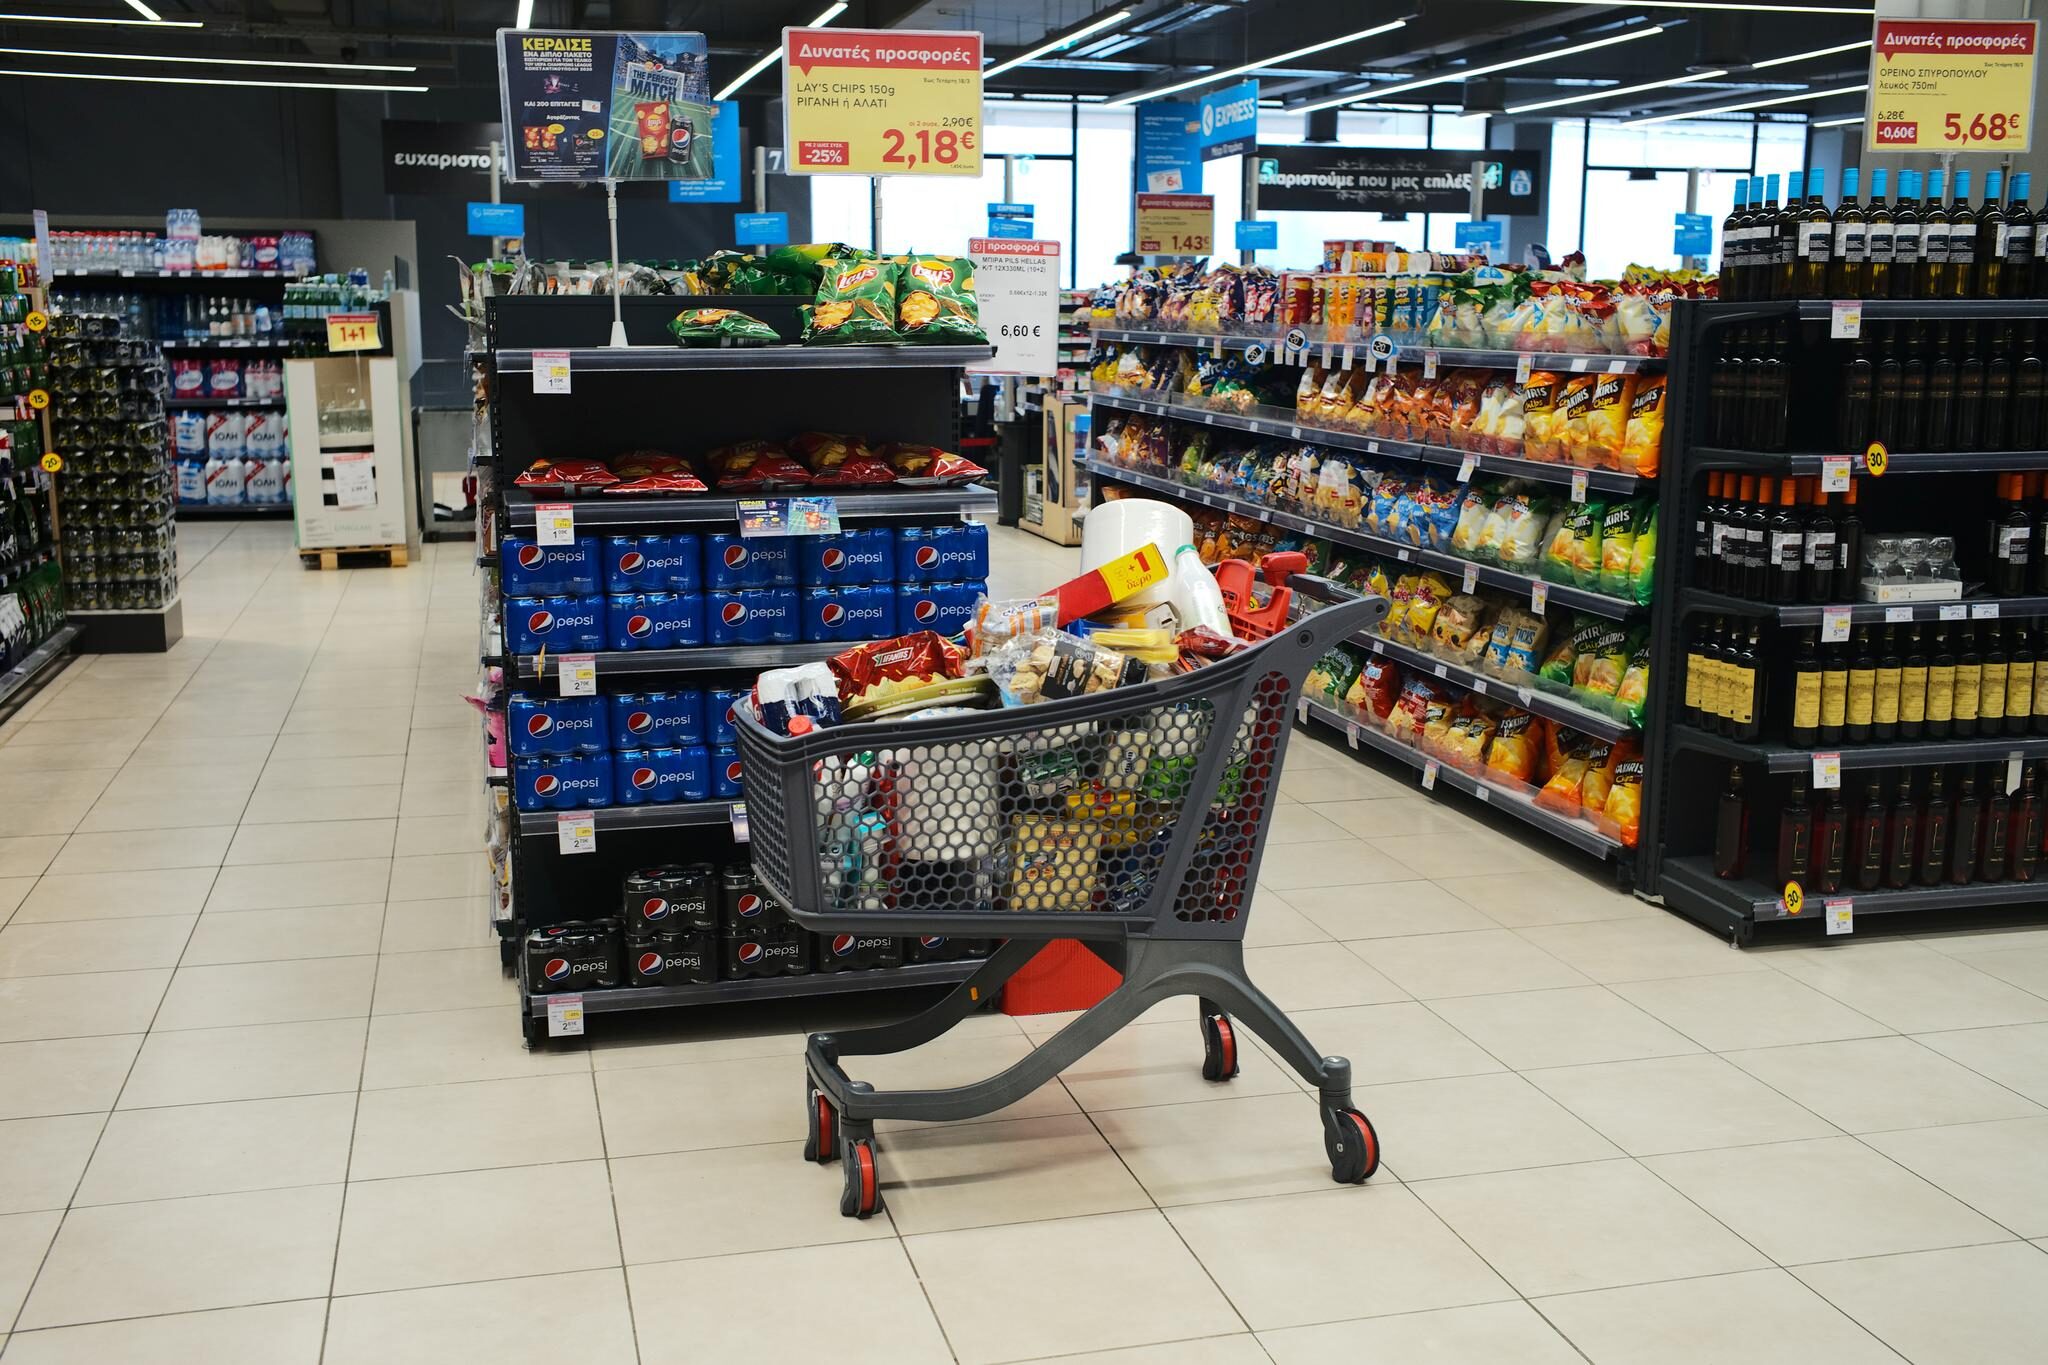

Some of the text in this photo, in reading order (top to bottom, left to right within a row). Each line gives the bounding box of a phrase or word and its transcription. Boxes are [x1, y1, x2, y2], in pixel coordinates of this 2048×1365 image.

[522, 37, 592, 51] ΚΕΡΔΙΣΕ
[1884, 32, 2027, 49] Δυνατές προσφορές
[799, 43, 971, 64] Δυνατές προσφορές
[633, 69, 678, 86] THE PERFECT
[1880, 68, 1987, 79] ΟΡΕΙΝΟ ΣΠΥΡΟΠΟΥΛΟΥ
[631, 79, 677, 100] MATCH
[832, 84, 866, 94] CHIPS
[869, 84, 896, 96] 150g
[1879, 80, 1937, 90] λευκός 750ml
[797, 97, 887, 109] ΡΙΓΑΝΗ ή ΑΛΑΤΙ
[1215, 97, 1255, 128] EXPRESS
[1877, 110, 1905, 120] 6,28€
[942, 117, 973, 128] 2,90€
[1944, 112, 2020, 145] 5,68€
[1879, 125, 1916, 139] -0,60€
[881, 128, 976, 169] 2,18€
[768, 151, 782, 171] 7
[805, 149, 842, 163] -25%
[1261, 161, 1275, 178] 5
[1359, 177, 1387, 188] που
[1392, 177, 1419, 190] μας
[988, 242, 1040, 254] προσφορά
[340, 326, 366, 342] 1+1
[1001, 325, 1041, 338] 6,60 €
[548, 550, 585, 563] pepsi
[646, 555, 683, 569] pepsi
[751, 549, 787, 563] pepsi
[847, 551, 883, 566] pepsi
[941, 550, 976, 564] pepsi
[749, 606, 786, 620] pepsi
[847, 607, 883, 620] pepsi
[556, 615, 594, 629] pepsi
[655, 618, 692, 632] pepsi
[556, 717, 593, 731] pepsi
[655, 714, 691, 729] pepsi
[562, 776, 599, 791] pepsi
[659, 771, 695, 785] pepsi
[671, 900, 706, 914] pepsi
[857, 937, 891, 950] pepsi
[765, 945, 799, 958] pepsi
[572, 960, 608, 974] pepsi
[665, 956, 701, 970] pepsi
